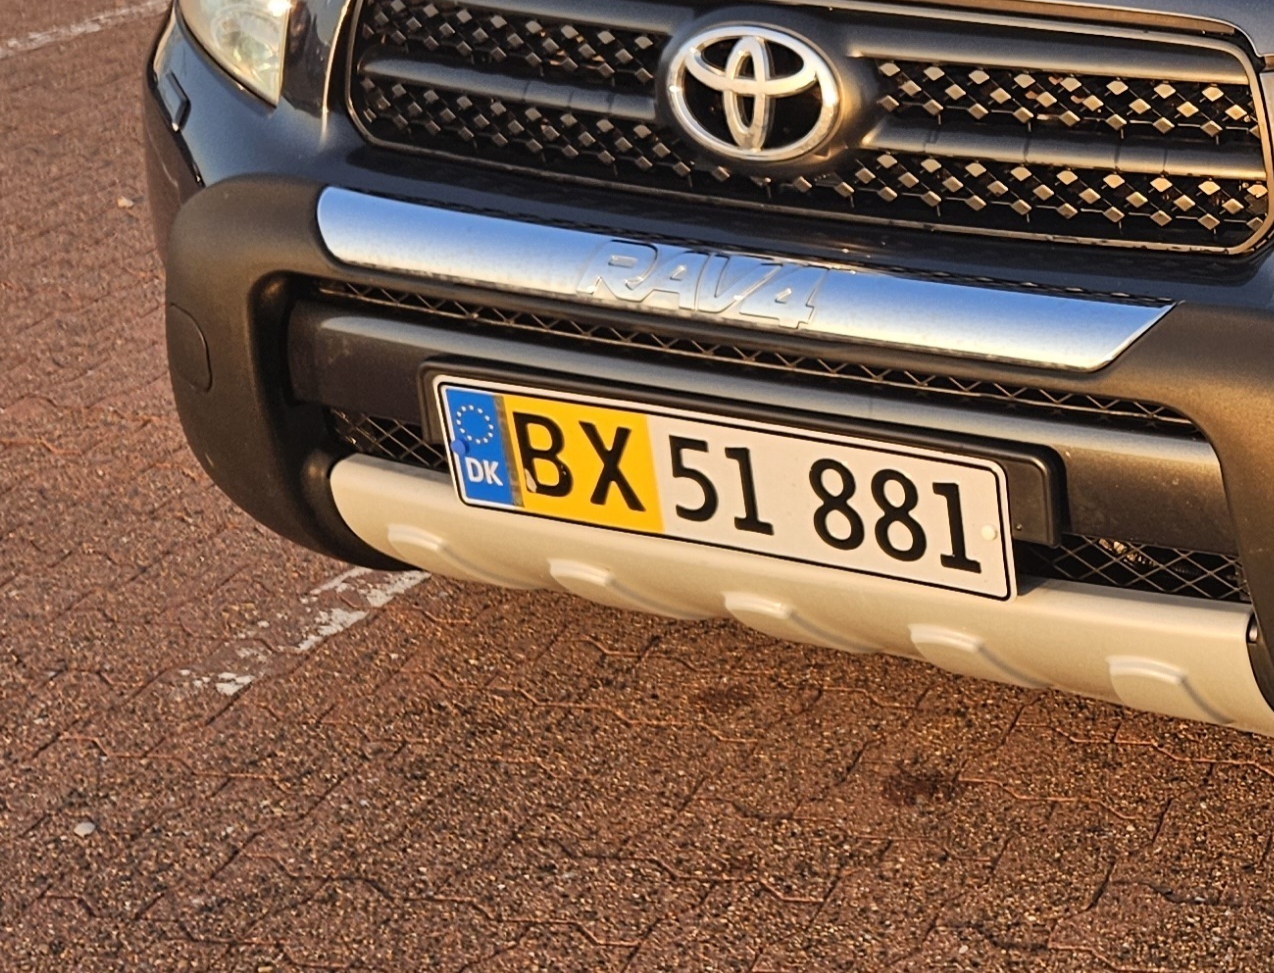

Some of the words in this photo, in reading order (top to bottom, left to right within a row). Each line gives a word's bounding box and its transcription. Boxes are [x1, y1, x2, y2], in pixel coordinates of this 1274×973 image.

[575, 238, 831, 330] RAV4
[467, 459, 504, 487] DK
[512, 411, 646, 513] BX
[668, 435, 774, 536] 51
[808, 458, 983, 574] 881
